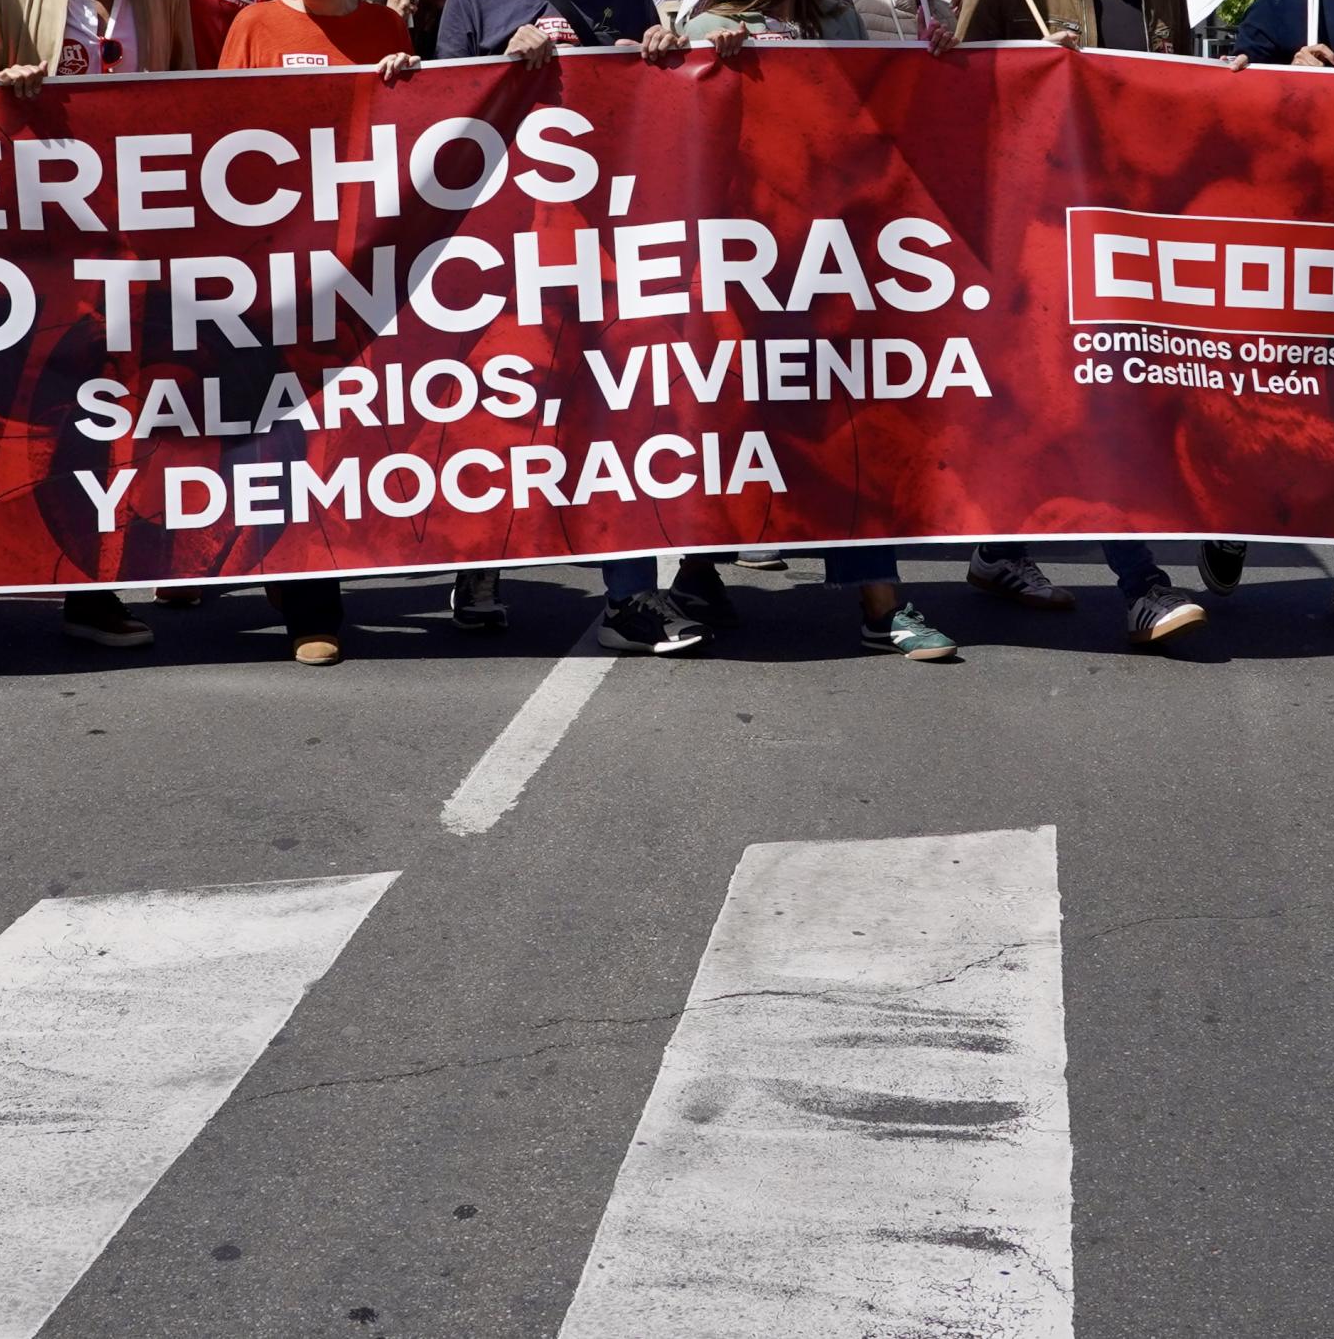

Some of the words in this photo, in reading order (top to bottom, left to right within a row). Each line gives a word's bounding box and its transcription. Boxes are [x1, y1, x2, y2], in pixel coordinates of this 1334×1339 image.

[539, 20, 569, 30] CCO
[62, 44, 83, 62] GT
[286, 56, 325, 67] CCOO
[73, 217, 990, 353] TRINCHERAS.
[1073, 326, 1233, 360] comisiones
[73, 355, 562, 442] SALARIOS,
[584, 337, 993, 411] VIVIENDA
[1073, 358, 1114, 384] de
[1123, 357, 1224, 390] Castilla
[1232, 372, 1245, 396] y
[1252, 369, 1320, 395] León
[73, 468, 138, 533] Y
[166, 430, 788, 530] DEMOCRACIA
